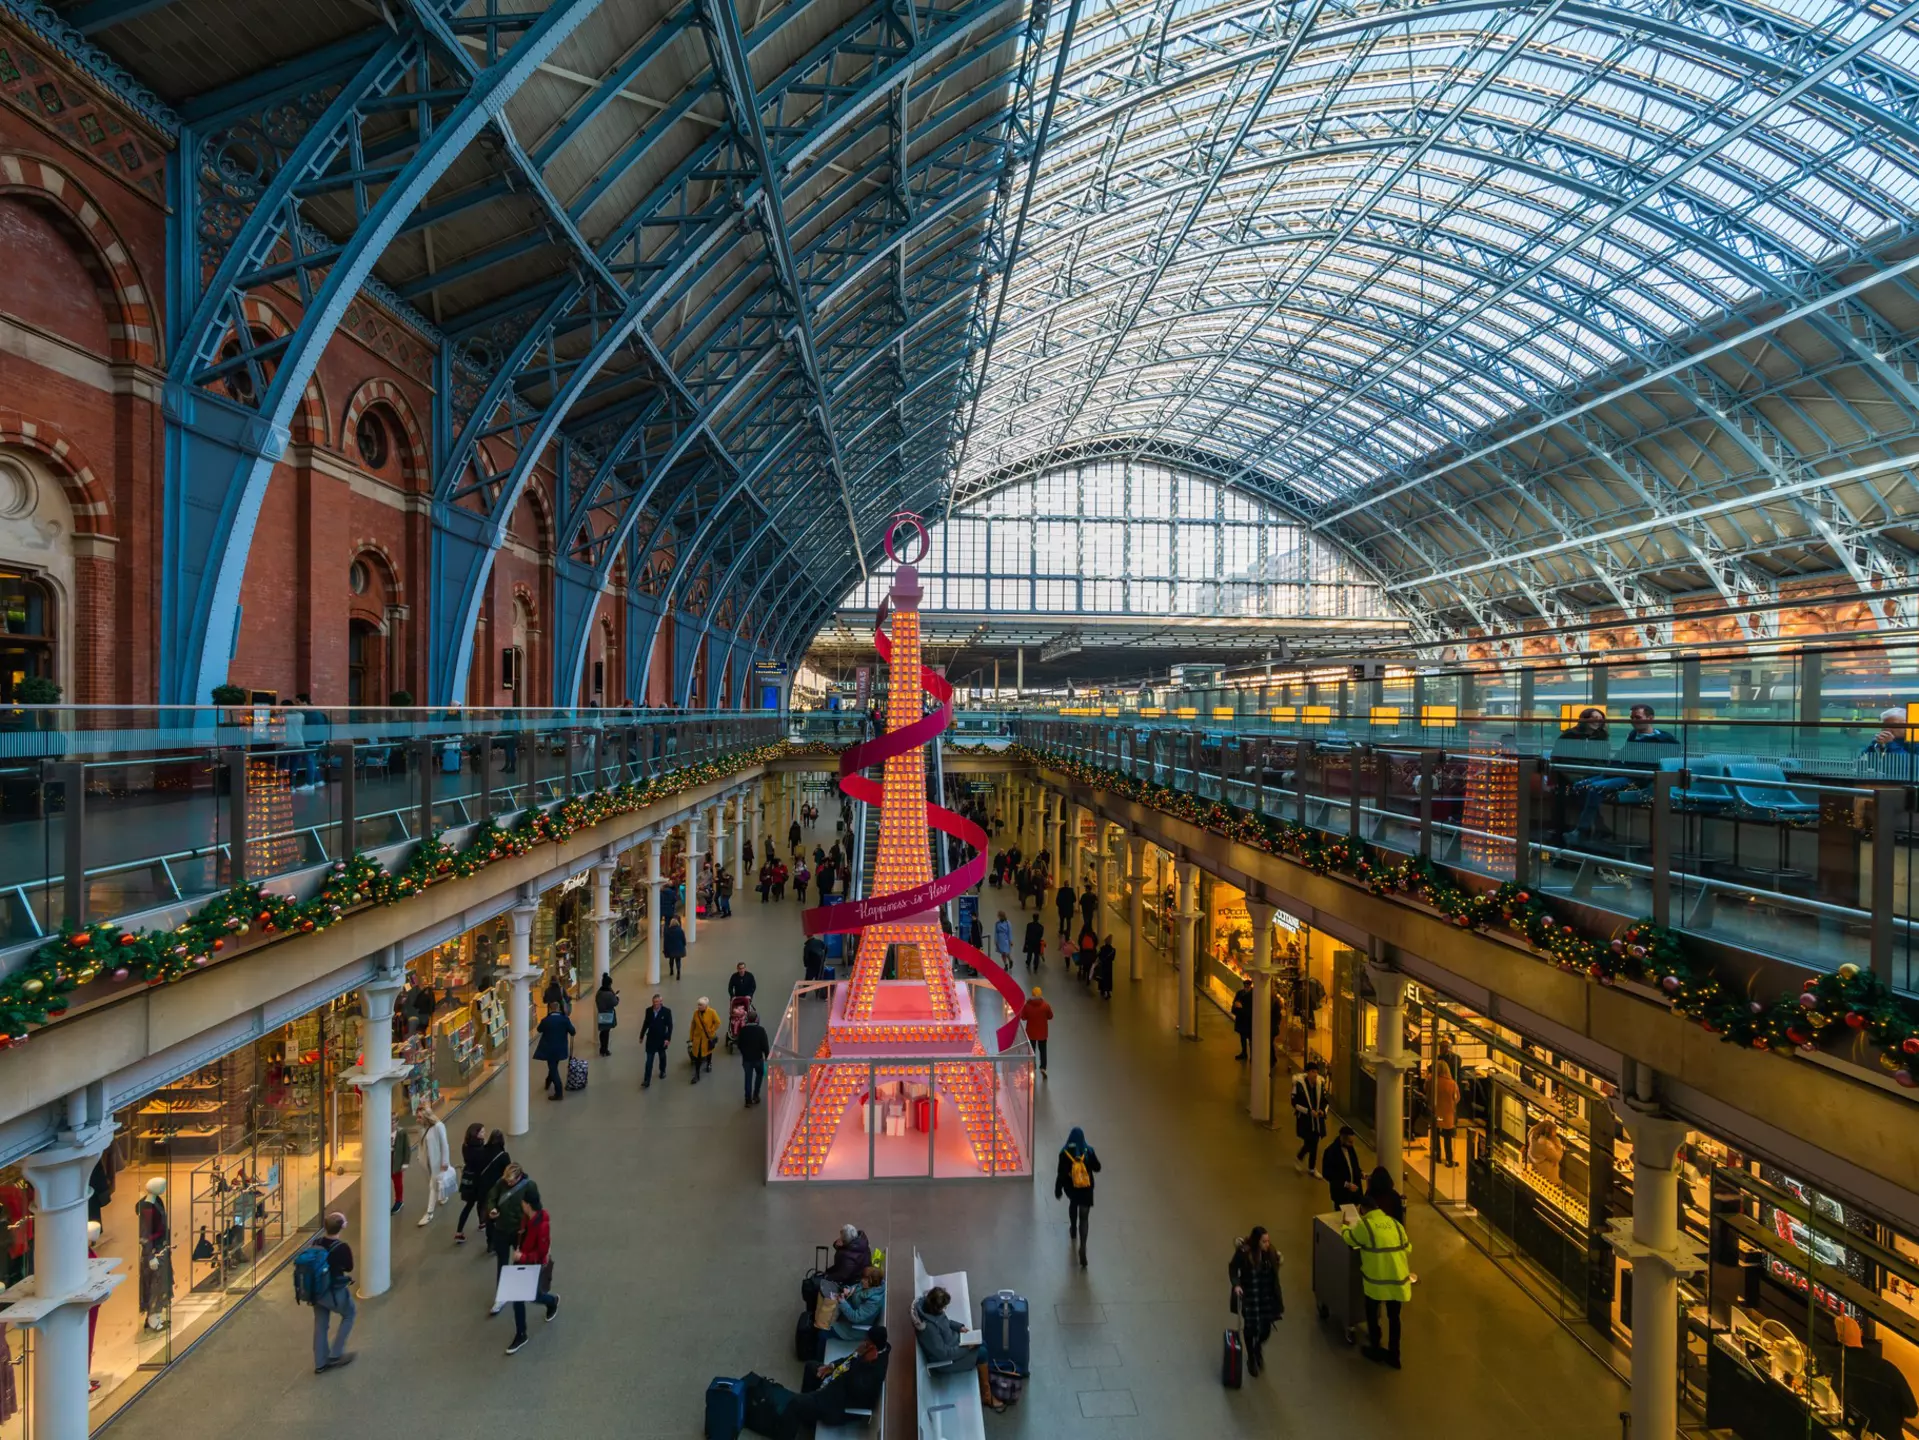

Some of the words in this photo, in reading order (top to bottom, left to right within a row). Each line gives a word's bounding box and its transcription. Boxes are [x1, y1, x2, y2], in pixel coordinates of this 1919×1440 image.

[1751, 686, 1762, 701] 7
[855, 899, 909, 921] Happiness
[910, 892, 925, 905] is
[1404, 983, 1424, 1006] EL
[1772, 1260, 1849, 1317] CHANEL
